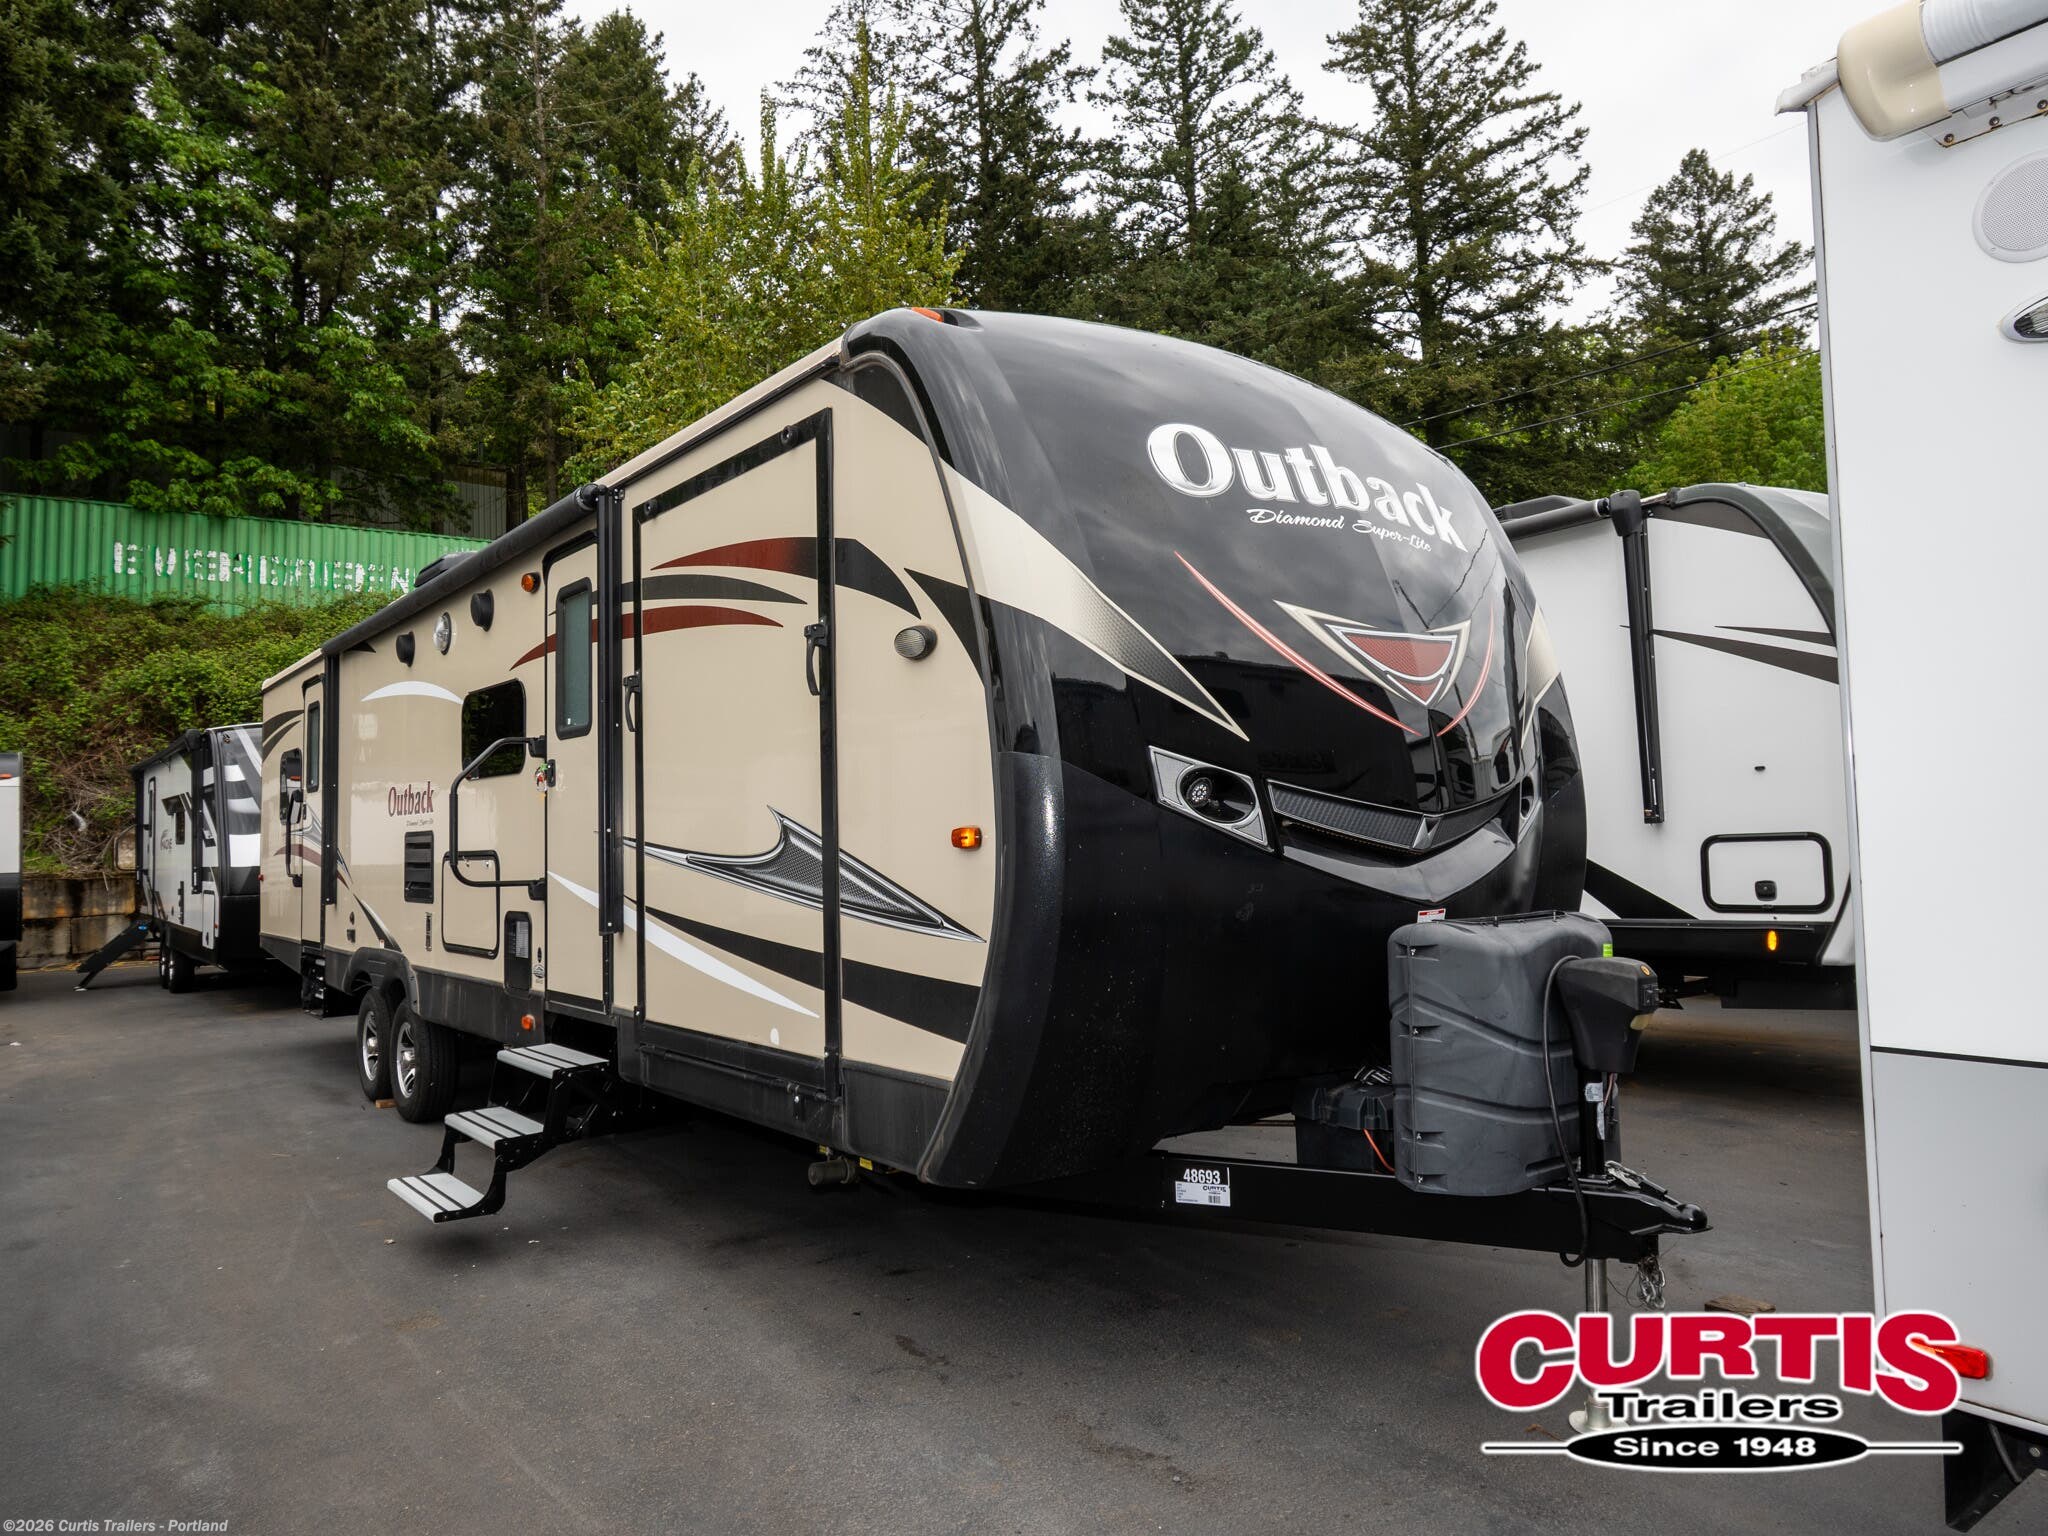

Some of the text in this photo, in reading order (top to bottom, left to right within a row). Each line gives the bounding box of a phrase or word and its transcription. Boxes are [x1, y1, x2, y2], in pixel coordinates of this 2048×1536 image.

[1147, 422, 1468, 552] Outback
[1246, 507, 1432, 552] Diamond Super-Lite
[388, 781, 434, 817] Outback
[1183, 1168, 1220, 1185] 48693
